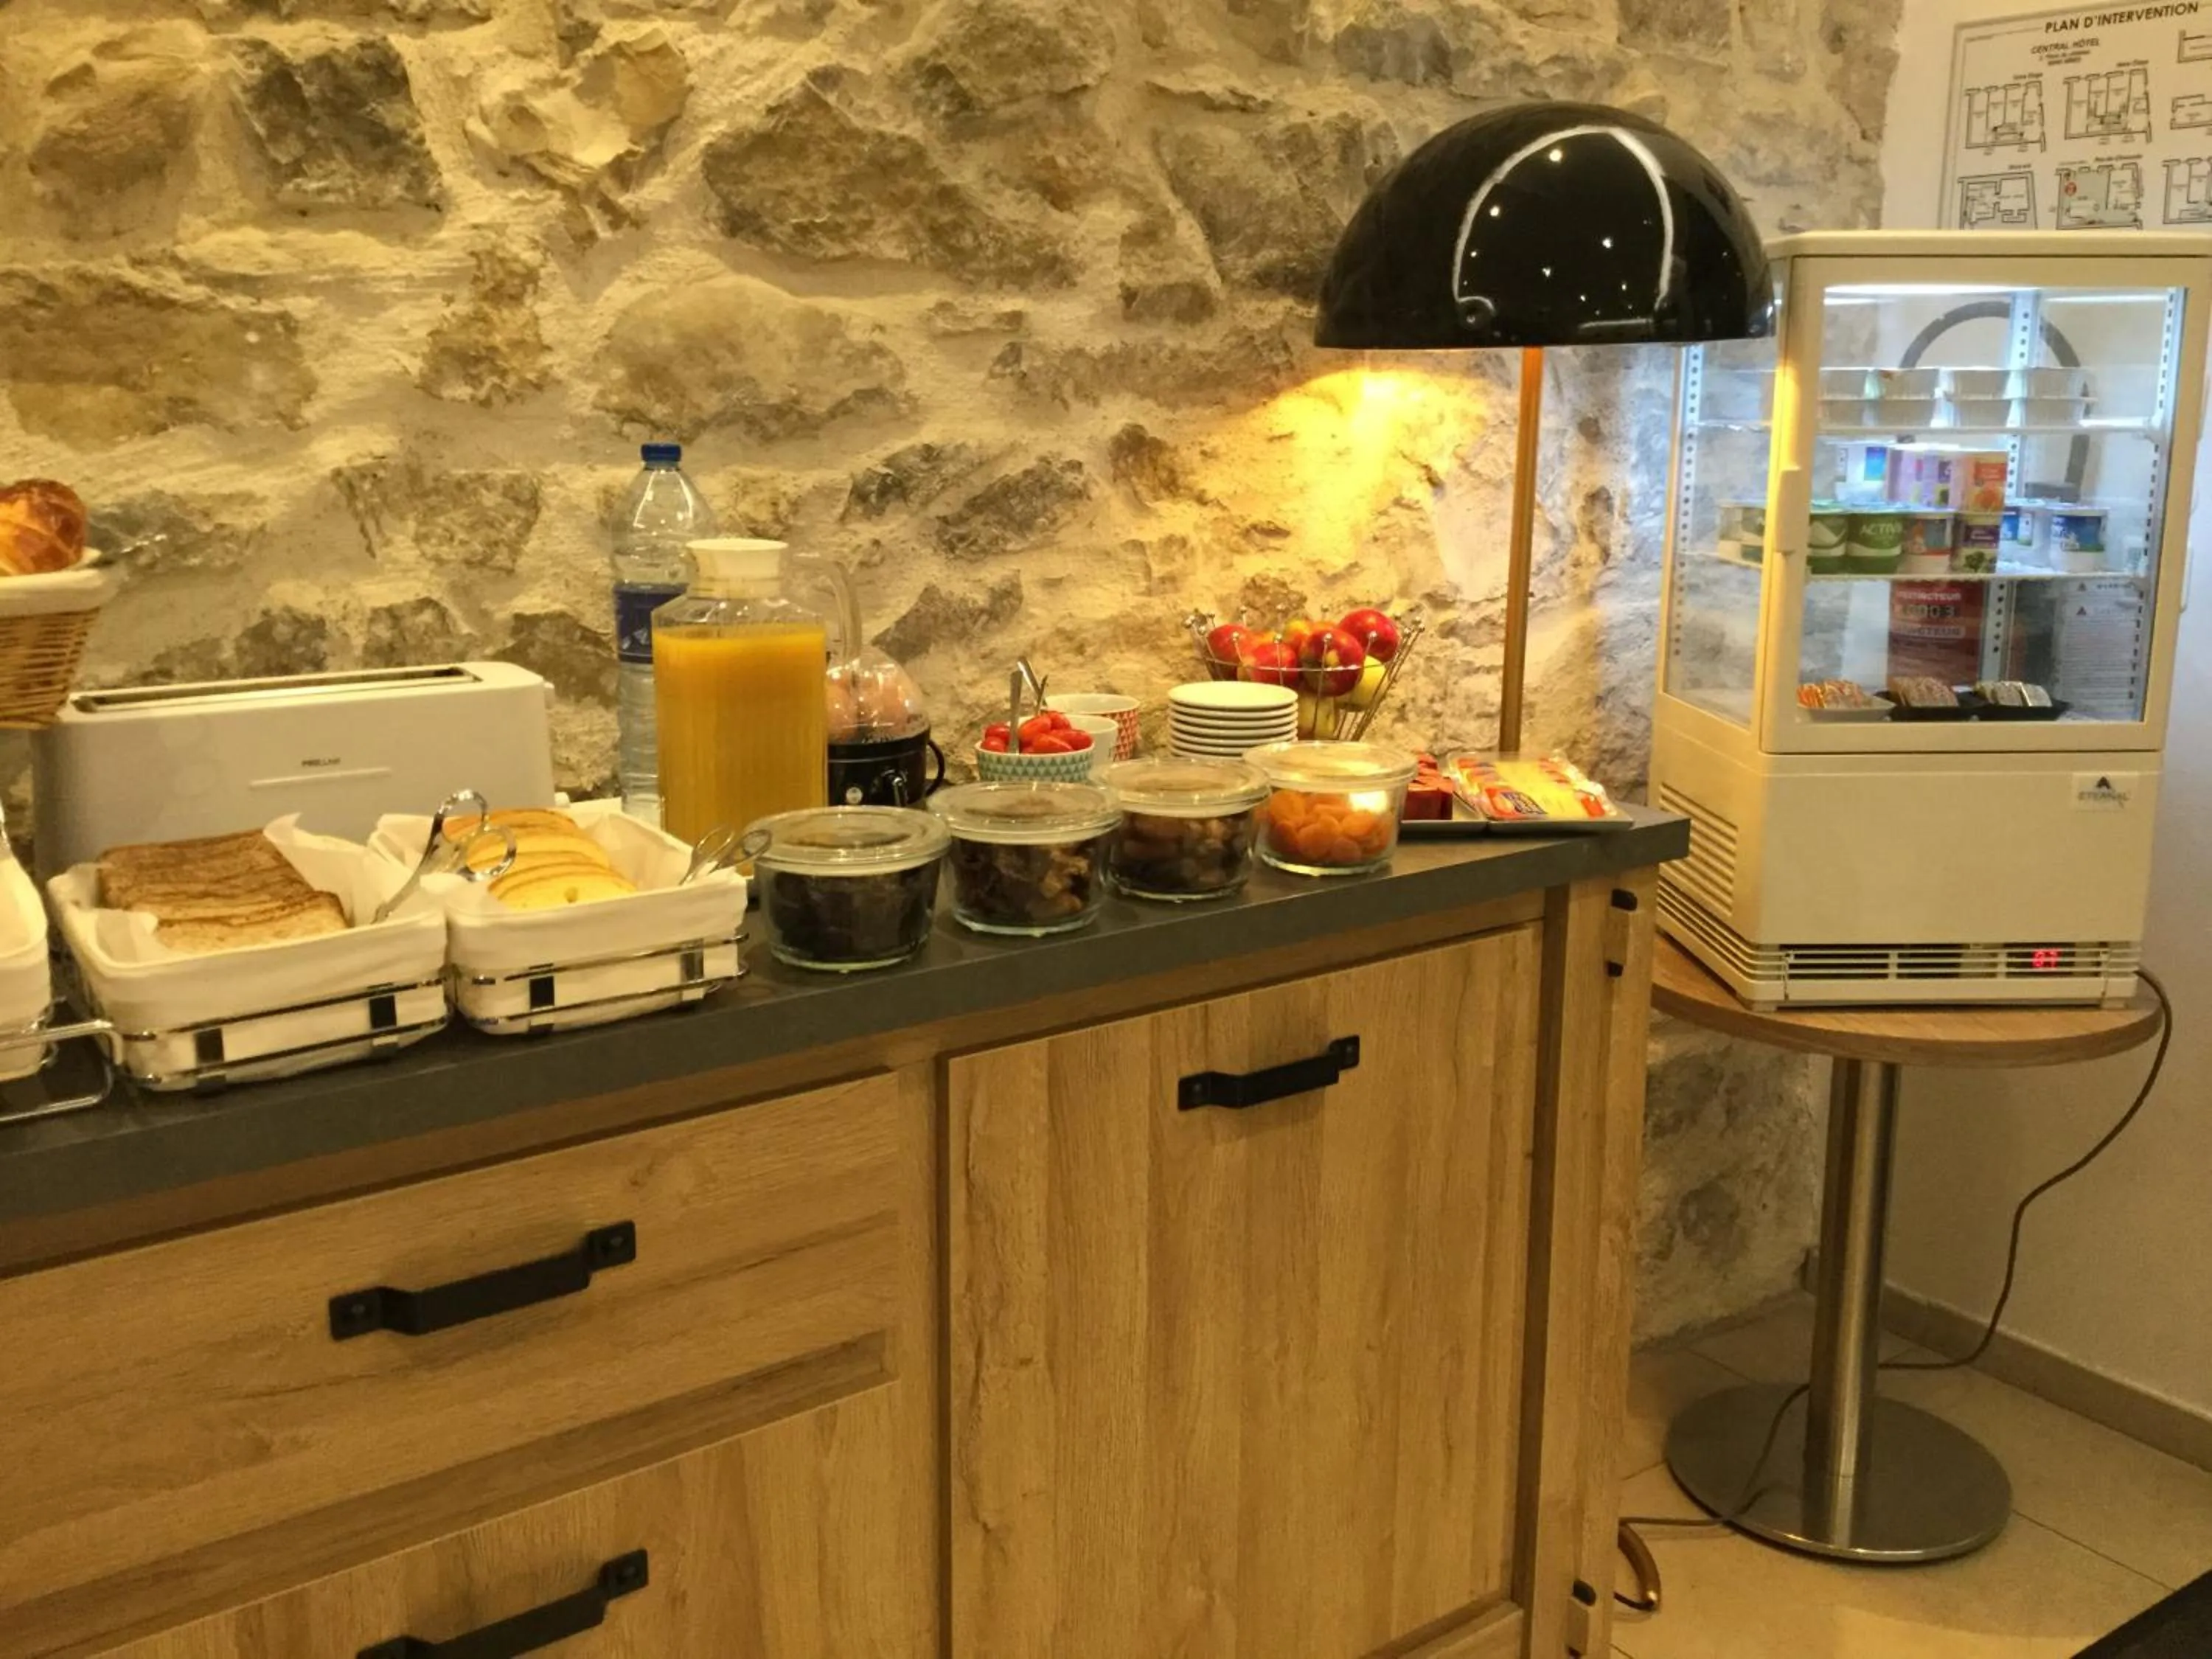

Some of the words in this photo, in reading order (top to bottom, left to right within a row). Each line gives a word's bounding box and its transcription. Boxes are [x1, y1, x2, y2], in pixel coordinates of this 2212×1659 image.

[2045, 19, 2079, 33] PLAN
[2084, 2, 2199, 28] D'INTERVENTION
[2031, 43, 2069, 54] CENTRAL
